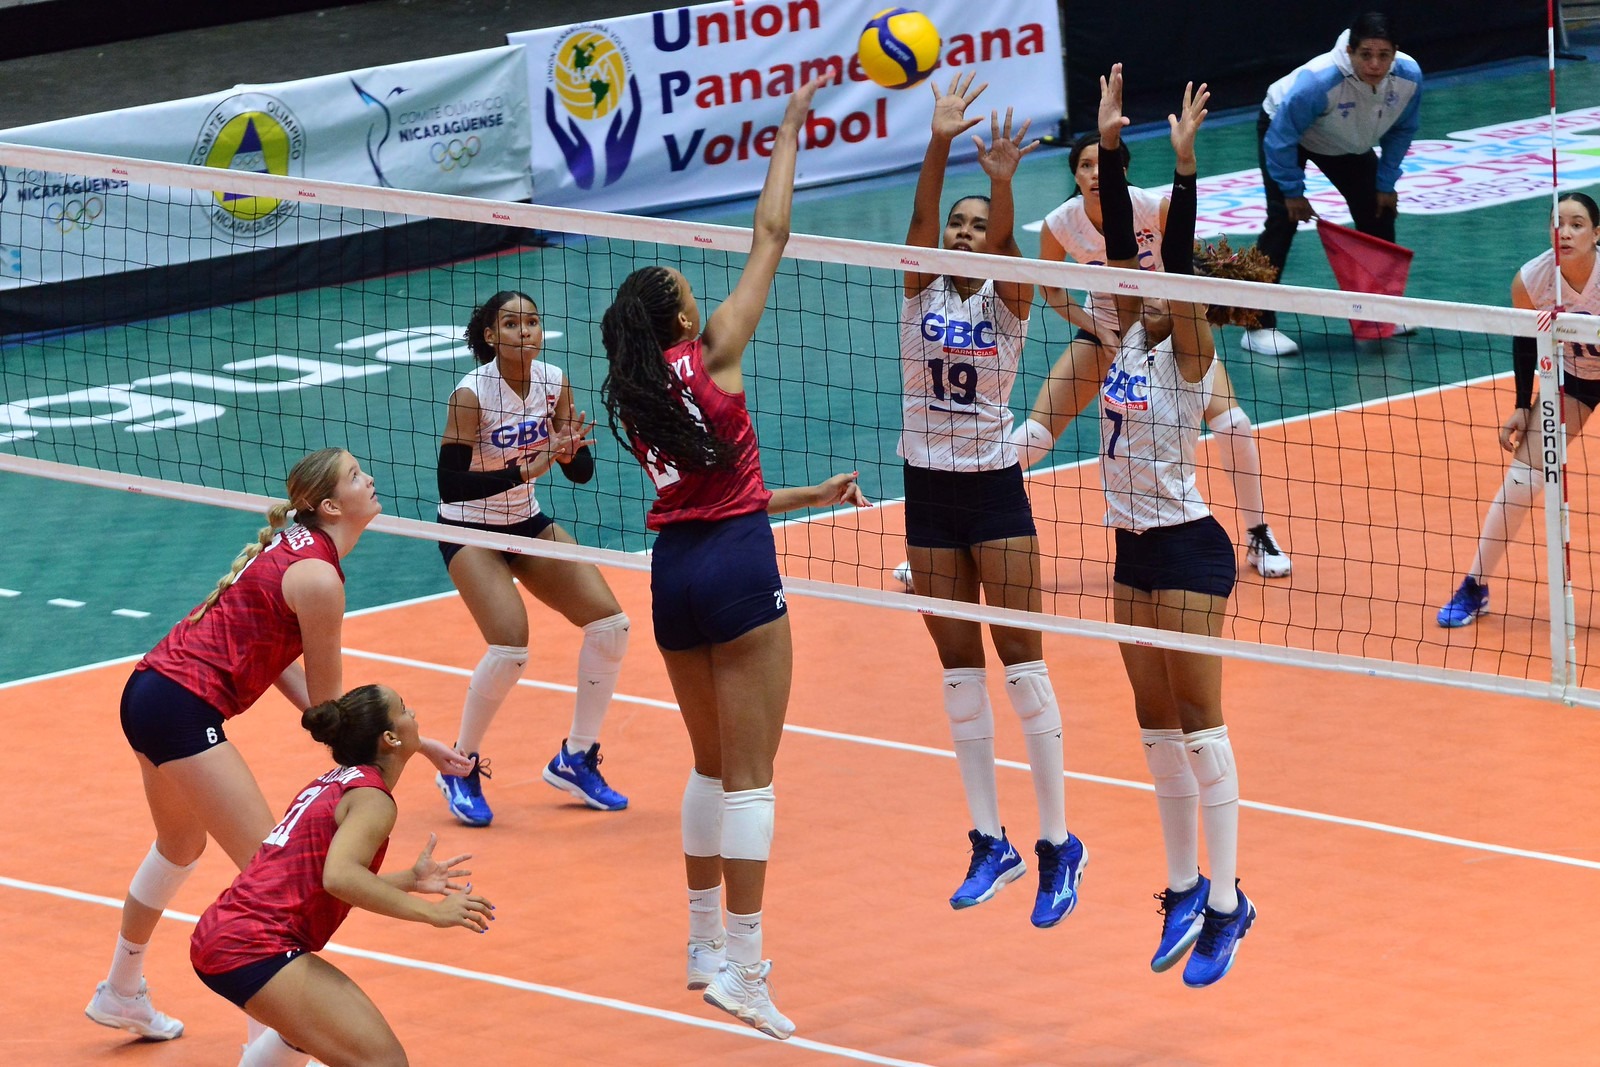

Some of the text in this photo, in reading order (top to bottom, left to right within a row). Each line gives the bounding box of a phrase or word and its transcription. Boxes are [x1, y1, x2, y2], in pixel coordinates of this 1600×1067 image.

[653, 0, 821, 52] Union
[660, 22, 1045, 115] Panameana
[398, 113, 504, 143] NICARAGÜENSE
[663, 97, 888, 173] Volebol
[920, 312, 997, 349] GBC
[950, 347, 995, 357] FARMACIAS
[0, 324, 564, 443] gua
[927, 358, 978, 405] 19
[1105, 407, 1123, 460] 7
[1542, 401, 1558, 484] Senoh
[206, 727, 218, 744] 6
